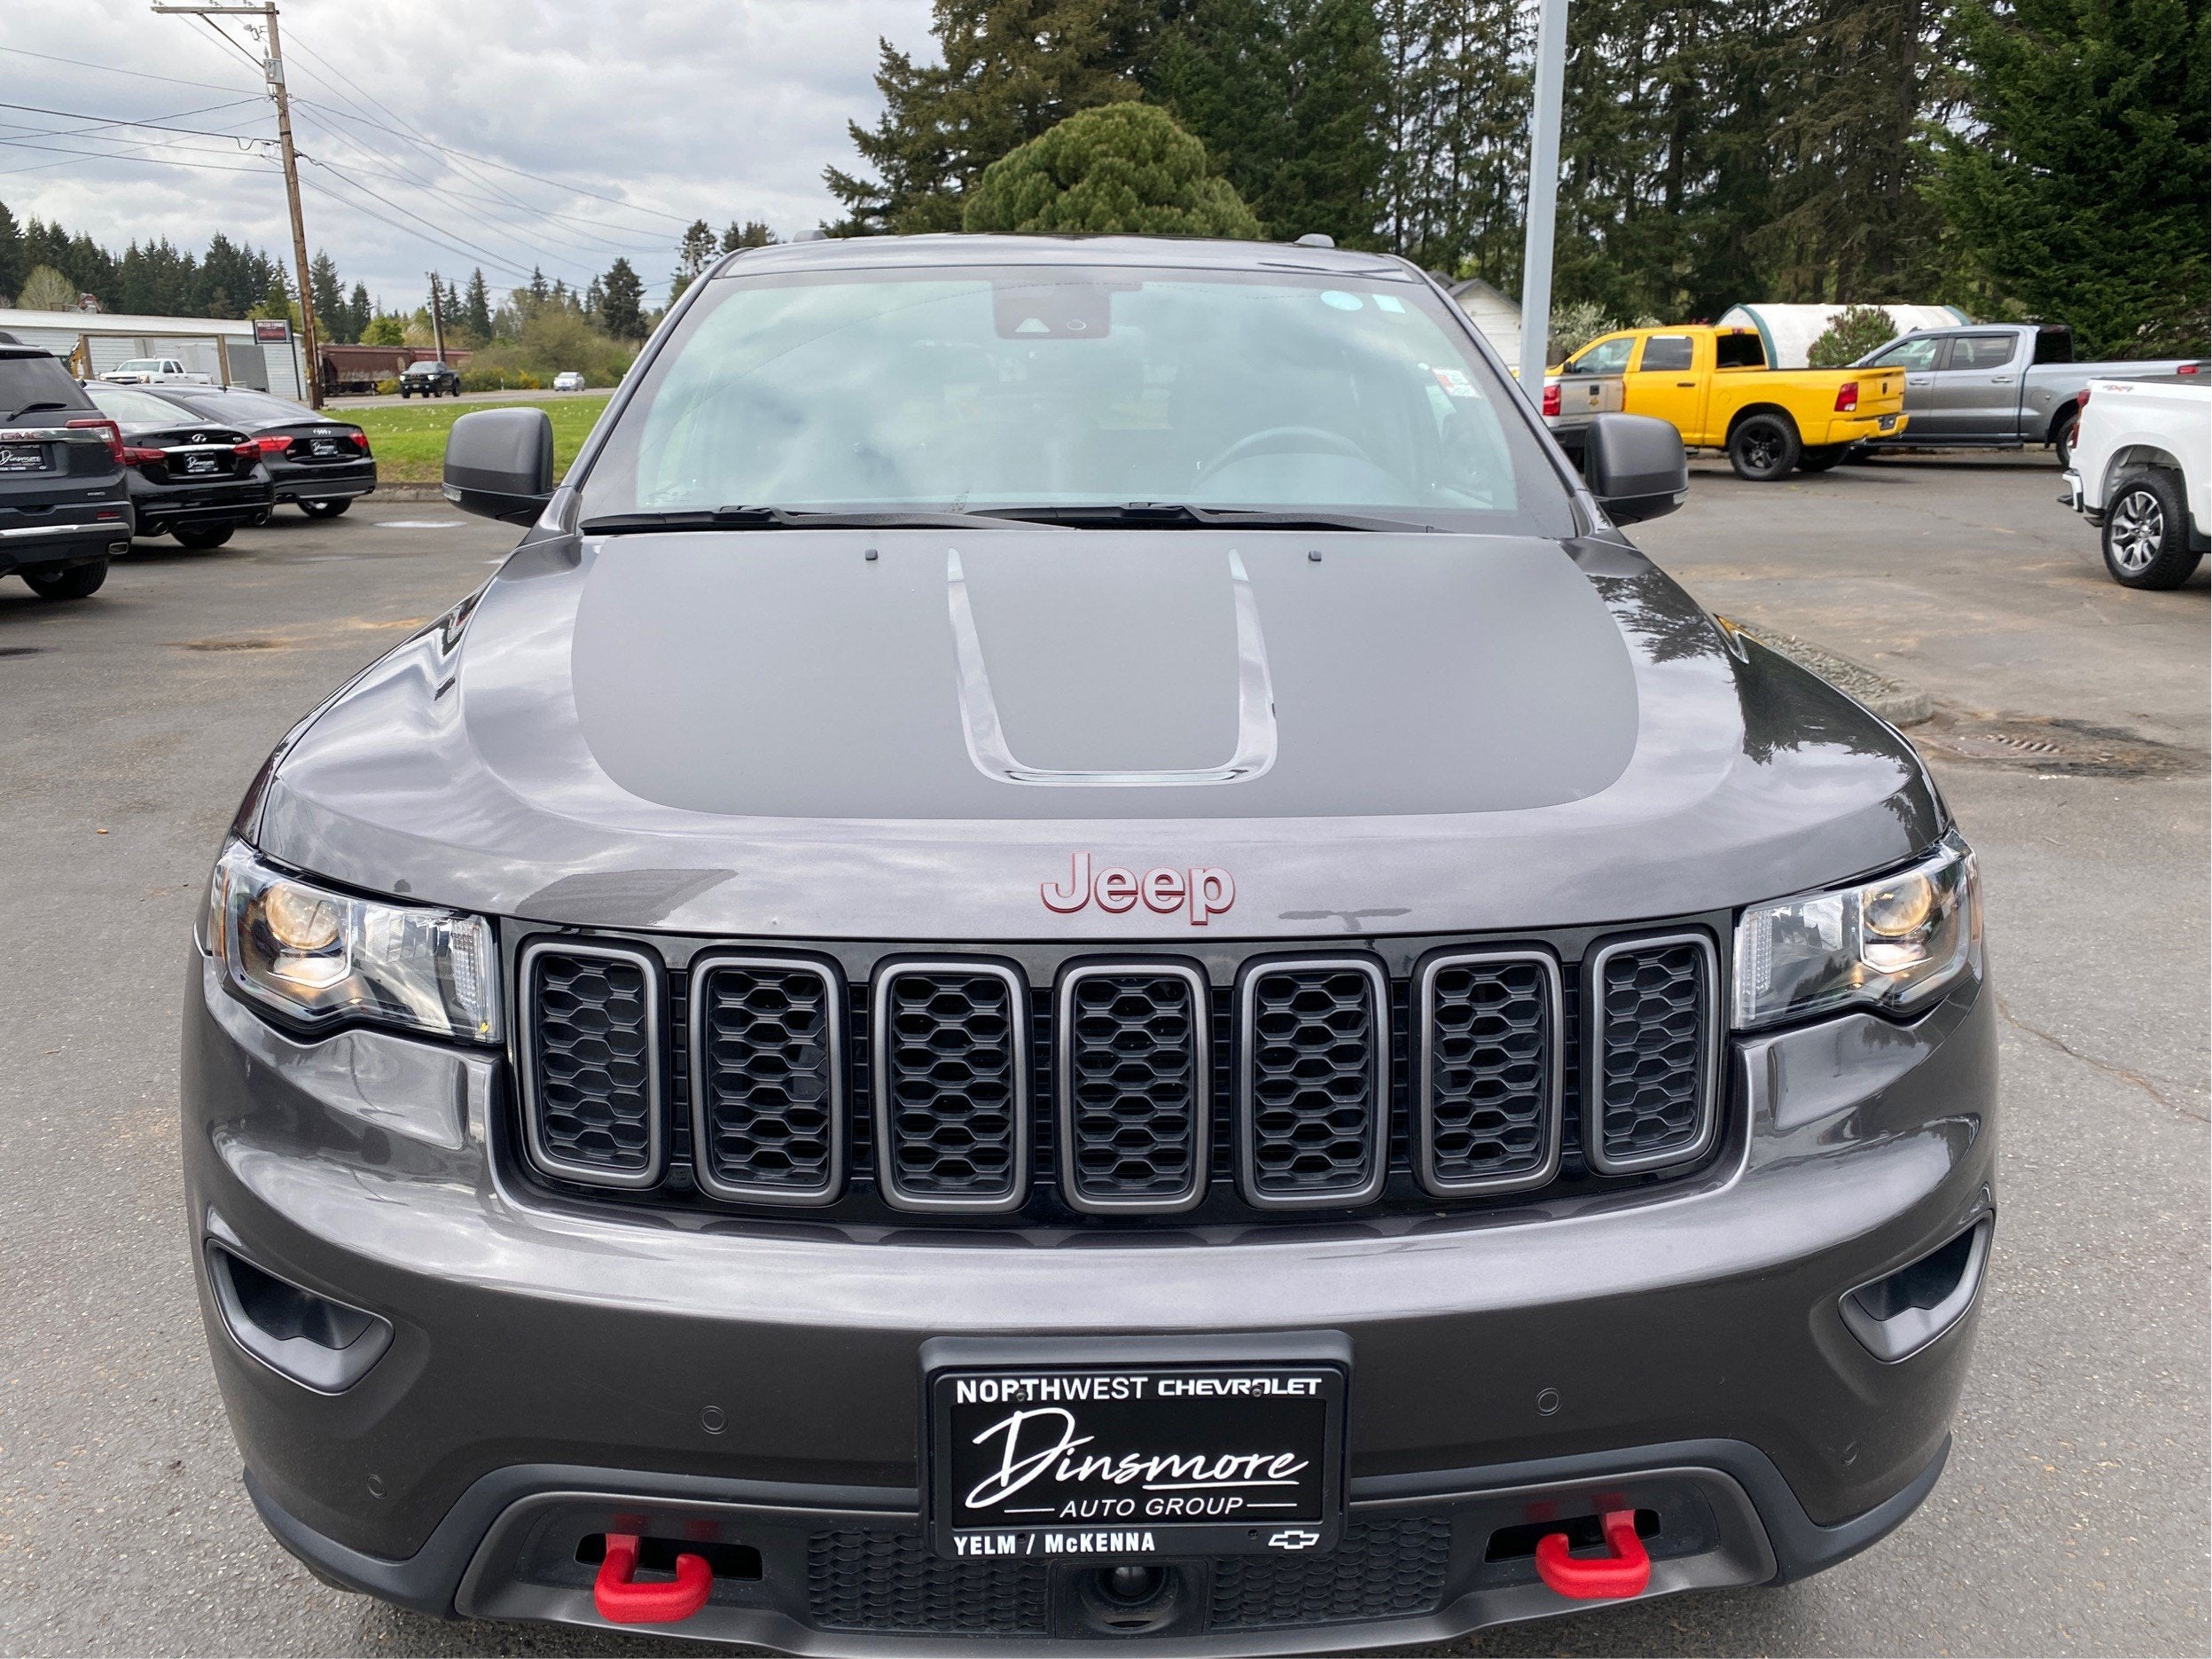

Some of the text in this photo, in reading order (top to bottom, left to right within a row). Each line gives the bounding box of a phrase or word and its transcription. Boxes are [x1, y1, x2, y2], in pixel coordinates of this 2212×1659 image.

[1, 432, 43, 441] GMC
[1041, 852, 1236, 926] Jeep
[957, 1376, 1323, 1404] NORTHWEST CHEVROLET
[965, 1406, 1309, 1509] Dinsmore
[1059, 1497, 1244, 1518] AUTO GROUP
[953, 1535, 1016, 1556] YELM
[1044, 1532, 1155, 1553] McKENNA
